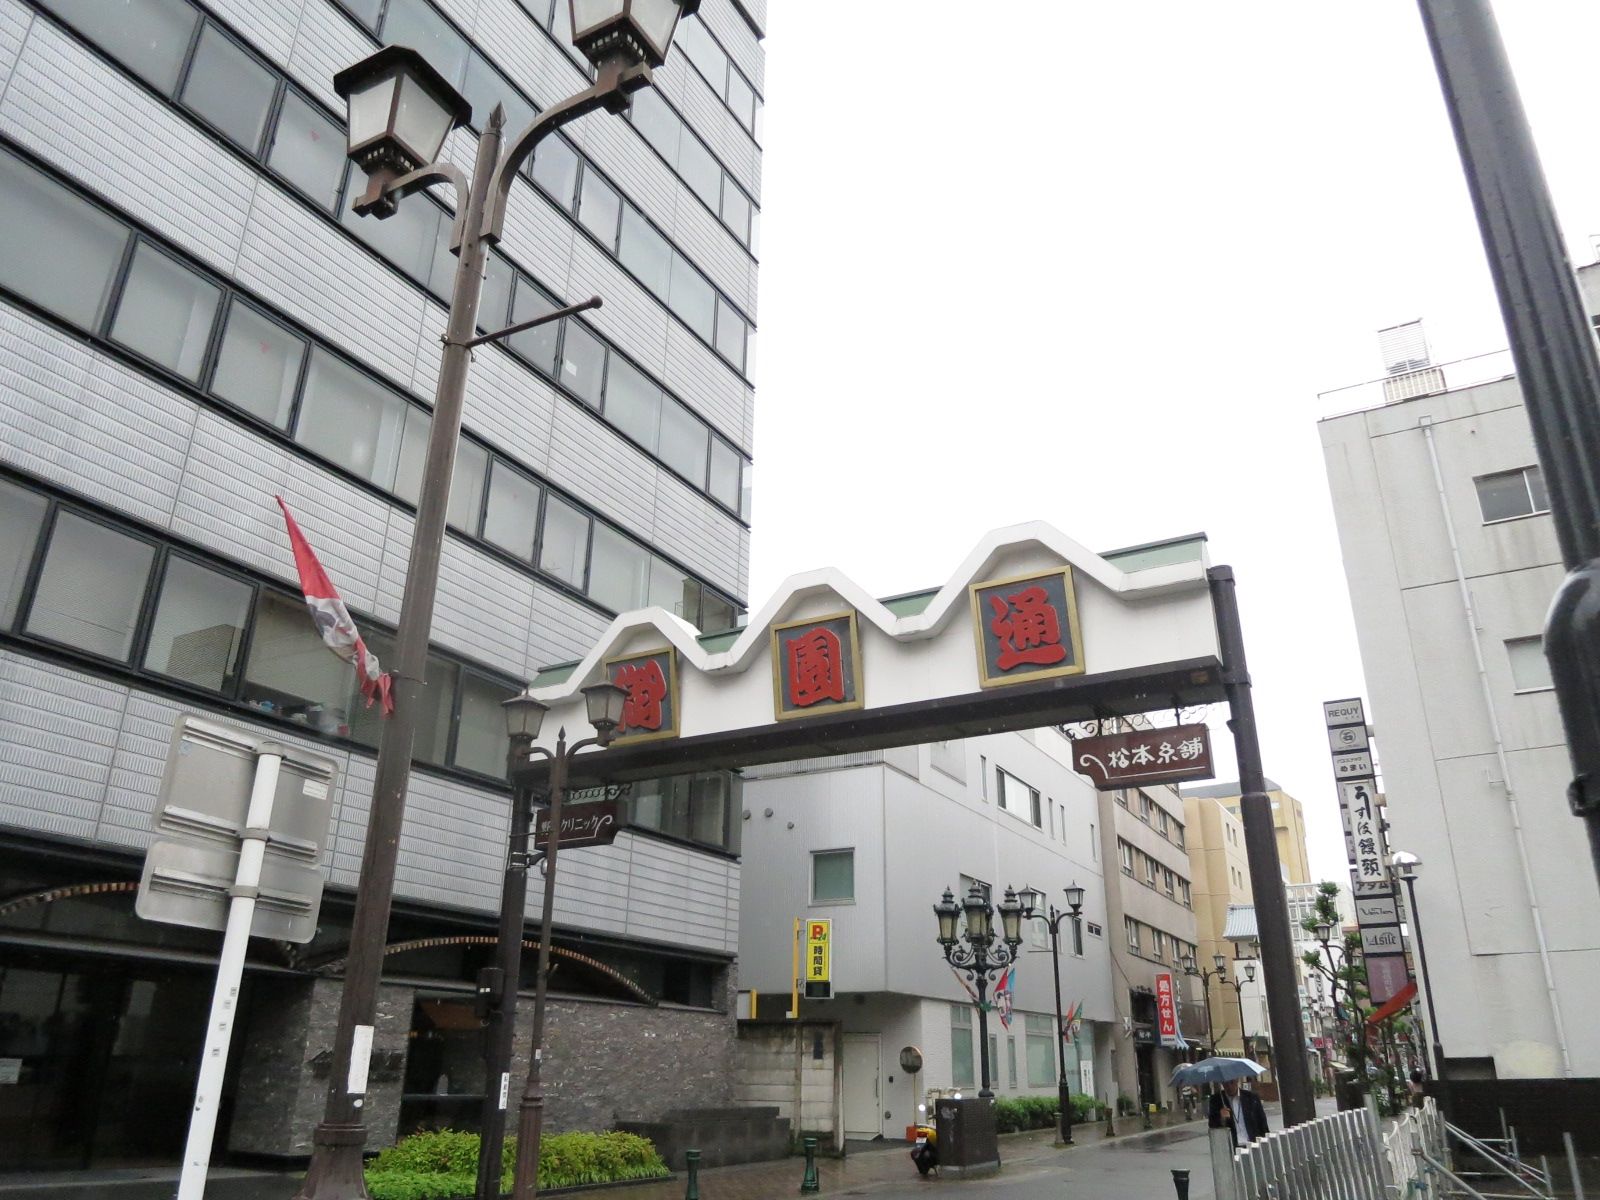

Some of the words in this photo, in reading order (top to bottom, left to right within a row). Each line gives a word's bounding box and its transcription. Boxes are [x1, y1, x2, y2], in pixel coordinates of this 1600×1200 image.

[813, 945, 823, 976] 時間貸
[1159, 980, 1173, 1032] 処方せん
